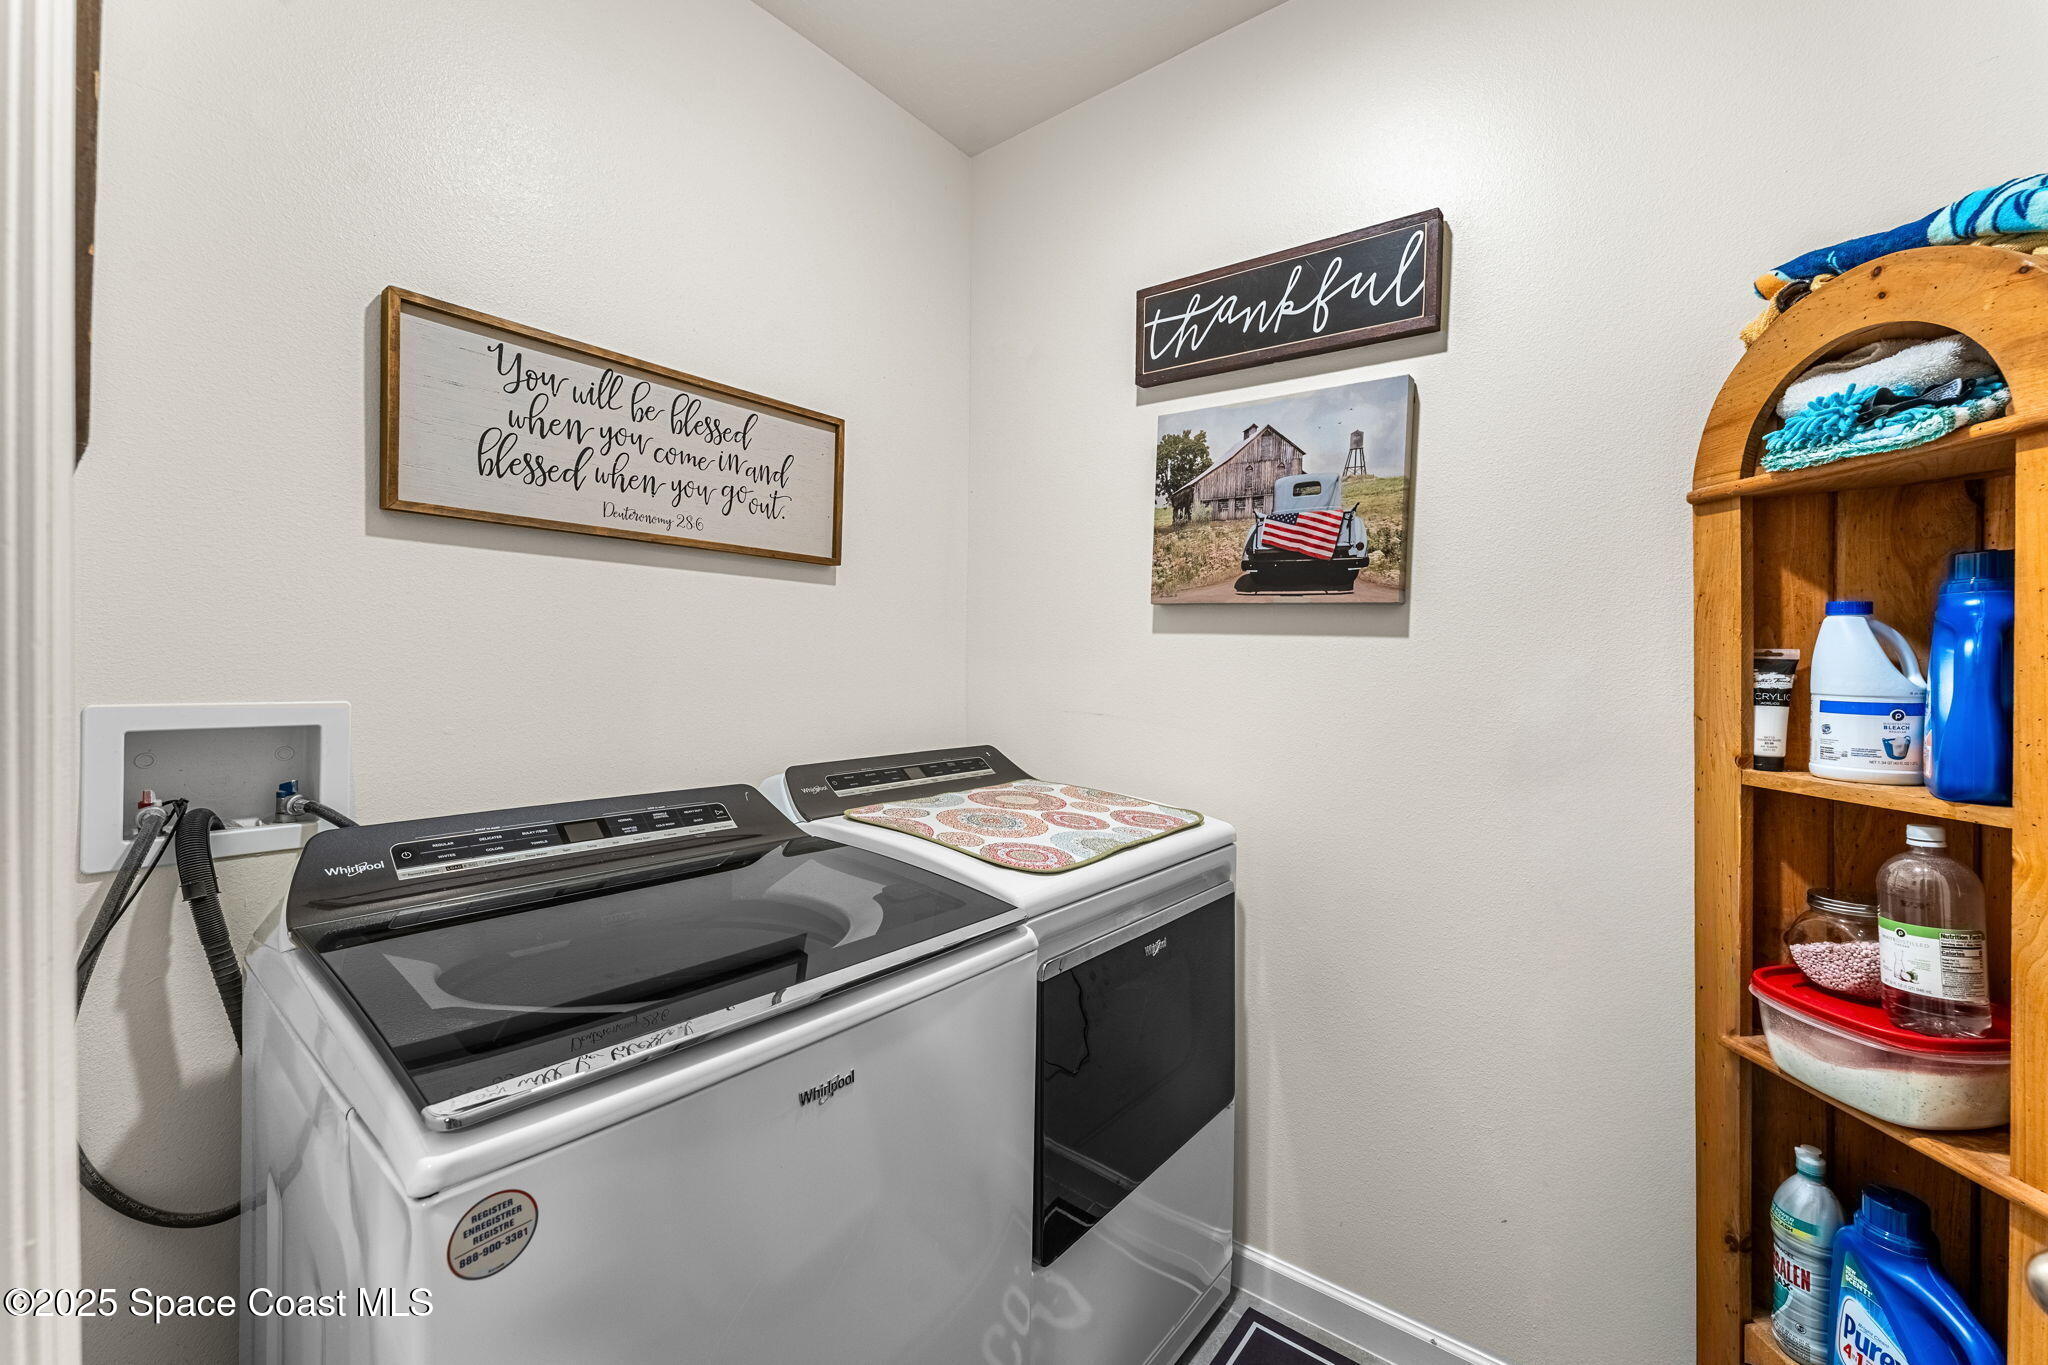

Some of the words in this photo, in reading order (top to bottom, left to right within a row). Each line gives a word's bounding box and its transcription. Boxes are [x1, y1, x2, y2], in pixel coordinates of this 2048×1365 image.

[1144, 230, 1425, 360] thankful
[487, 343, 570, 397] You
[573, 368, 623, 410] will
[631, 382, 666, 423] be
[670, 393, 759, 451] blessed
[508, 393, 595, 445] when
[600, 426, 654, 456] you
[653, 447, 716, 471] come
[718, 451, 748, 475] in
[745, 454, 795, 488] and
[477, 427, 595, 491] blessed
[595, 452, 666, 498] when
[671, 479, 717, 508] you
[721, 485, 755, 516] go
[749, 490, 792, 520] out.
[603, 501, 674, 532] Deuteronomy
[1755, 692, 1791, 702] CRYLIC
[324, 860, 384, 877] Whirlpool
[798, 1070, 855, 1107] Whirlpool
[463, 1204, 522, 1239] ENREGISTRER
[471, 1198, 513, 1224] REGISTER
[459, 1227, 528, 1269] 888-900-3381
[473, 1218, 515, 1245] REGISTRE
